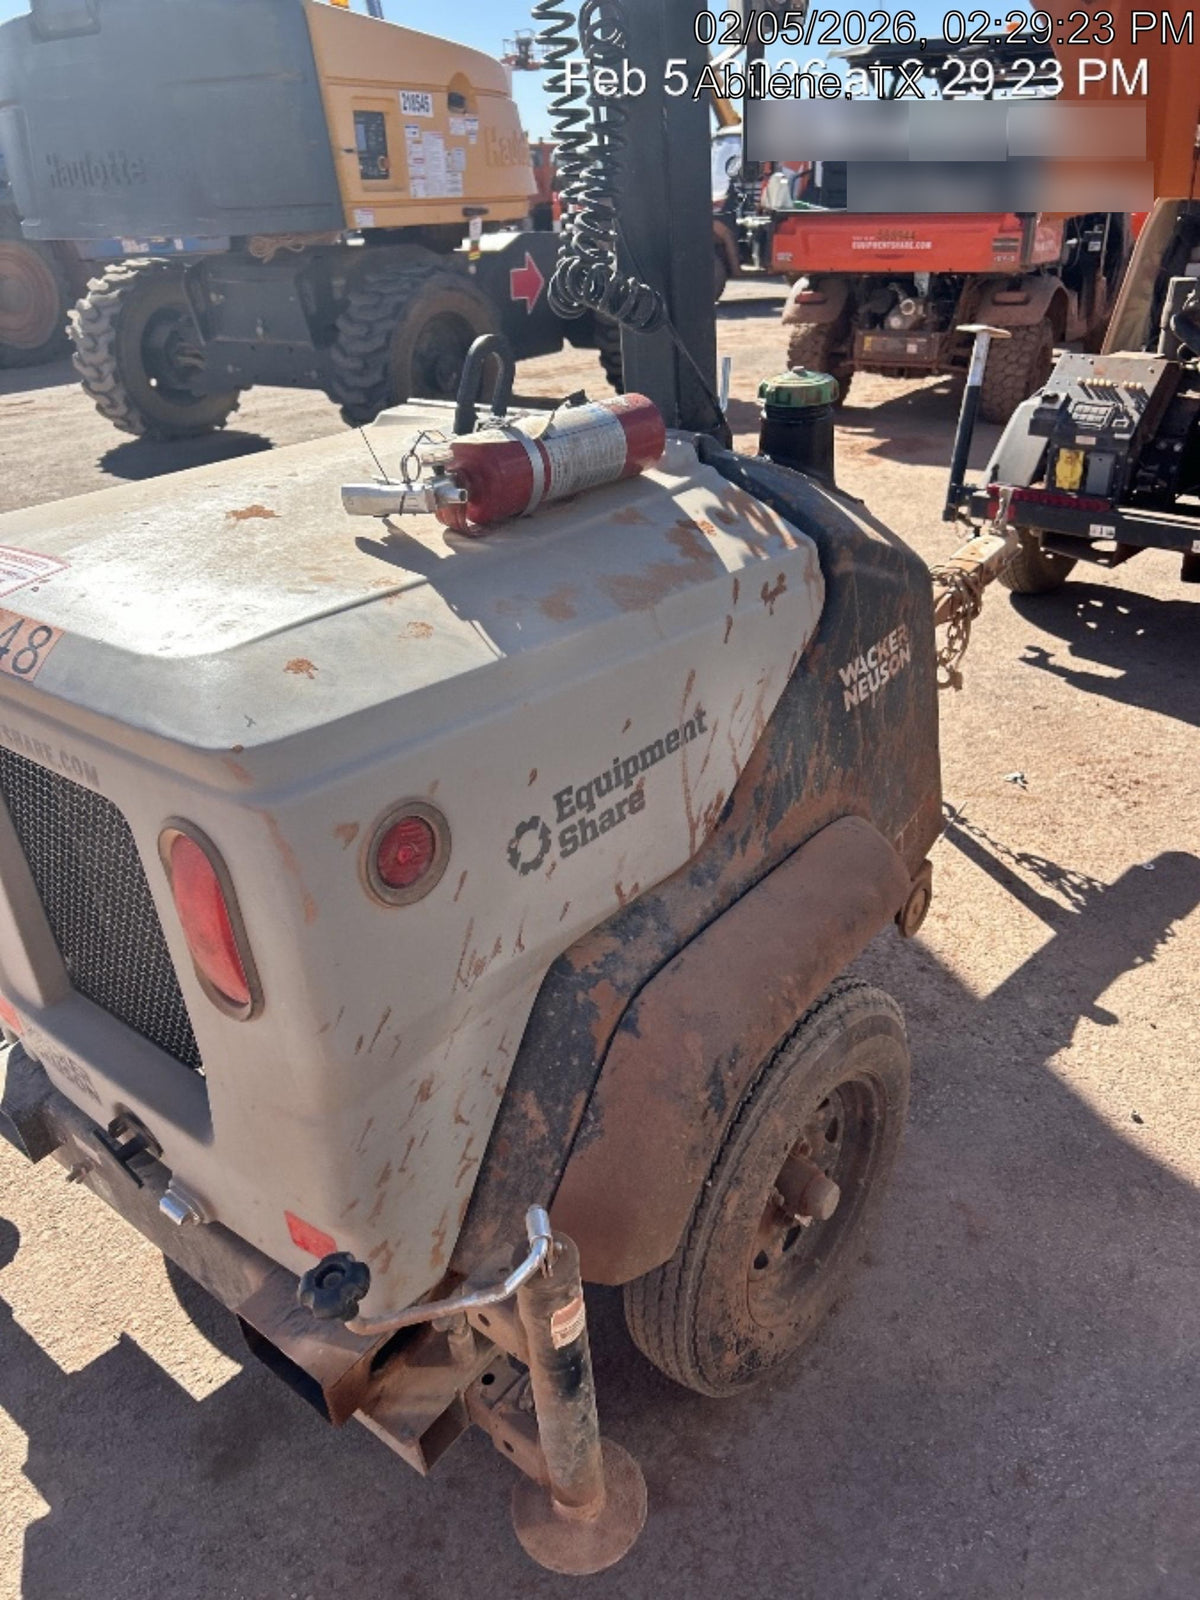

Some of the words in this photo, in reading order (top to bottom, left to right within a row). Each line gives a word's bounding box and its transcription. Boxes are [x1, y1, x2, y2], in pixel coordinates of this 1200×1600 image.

[838, 623, 909, 687] WACKER
[843, 643, 911, 712] NEUSON
[553, 708, 708, 824] Equipment
[558, 789, 646, 859] Share
